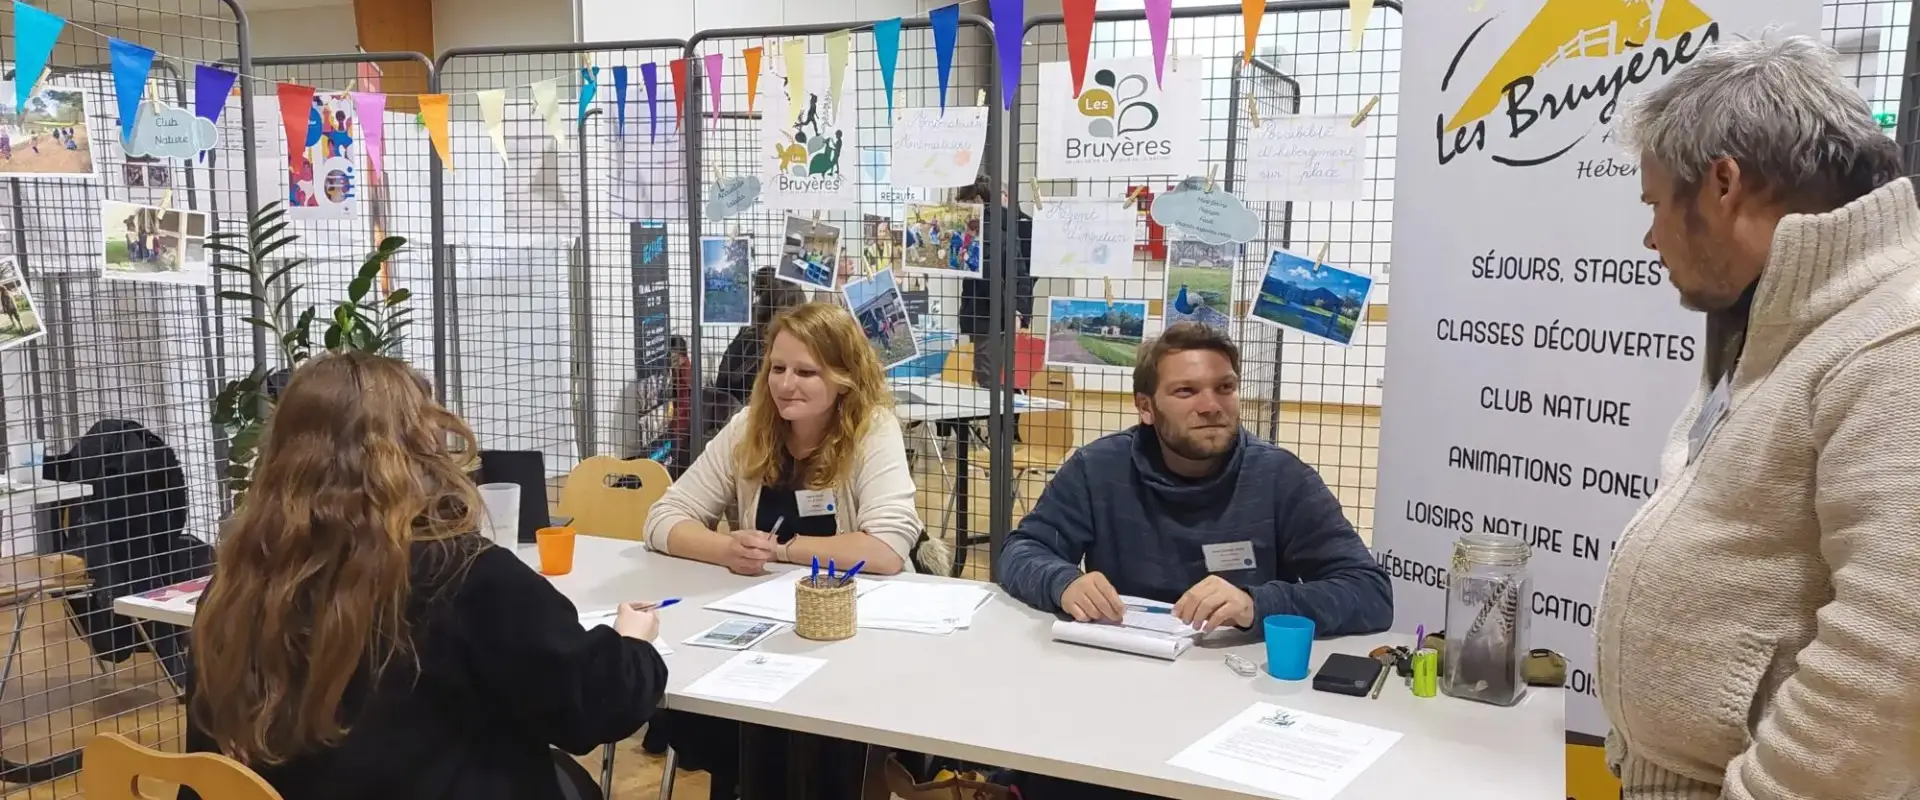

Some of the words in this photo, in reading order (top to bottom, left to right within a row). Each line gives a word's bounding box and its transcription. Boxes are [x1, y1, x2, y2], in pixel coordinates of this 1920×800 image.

[1085, 98, 1109, 111] Les
[1437, 112, 1486, 165] Les
[1501, 21, 1720, 139] Bruyères
[154, 134, 189, 145] Nature
[155, 117, 179, 127] Club
[1065, 136, 1172, 162] Bruyères
[779, 175, 840, 193] Bruyères
[1576, 157, 1641, 180] Héber
[1471, 249, 1565, 284] SÉJOURS,
[1573, 258, 1663, 286] STAGES
[1436, 318, 1525, 347] CLASSES
[1533, 319, 1696, 362] DÉCOUVERTES
[1480, 386, 1533, 414] CLUB
[1543, 392, 1631, 427] NATURE
[1448, 445, 1573, 487] ANIMATIONS
[1406, 499, 1474, 534] LOISIRS
[1483, 515, 1563, 554] NATURE
[1573, 533, 1600, 562] EN
[1376, 548, 1447, 591] HÉBERGE
[1531, 591, 1597, 629] CATIO
